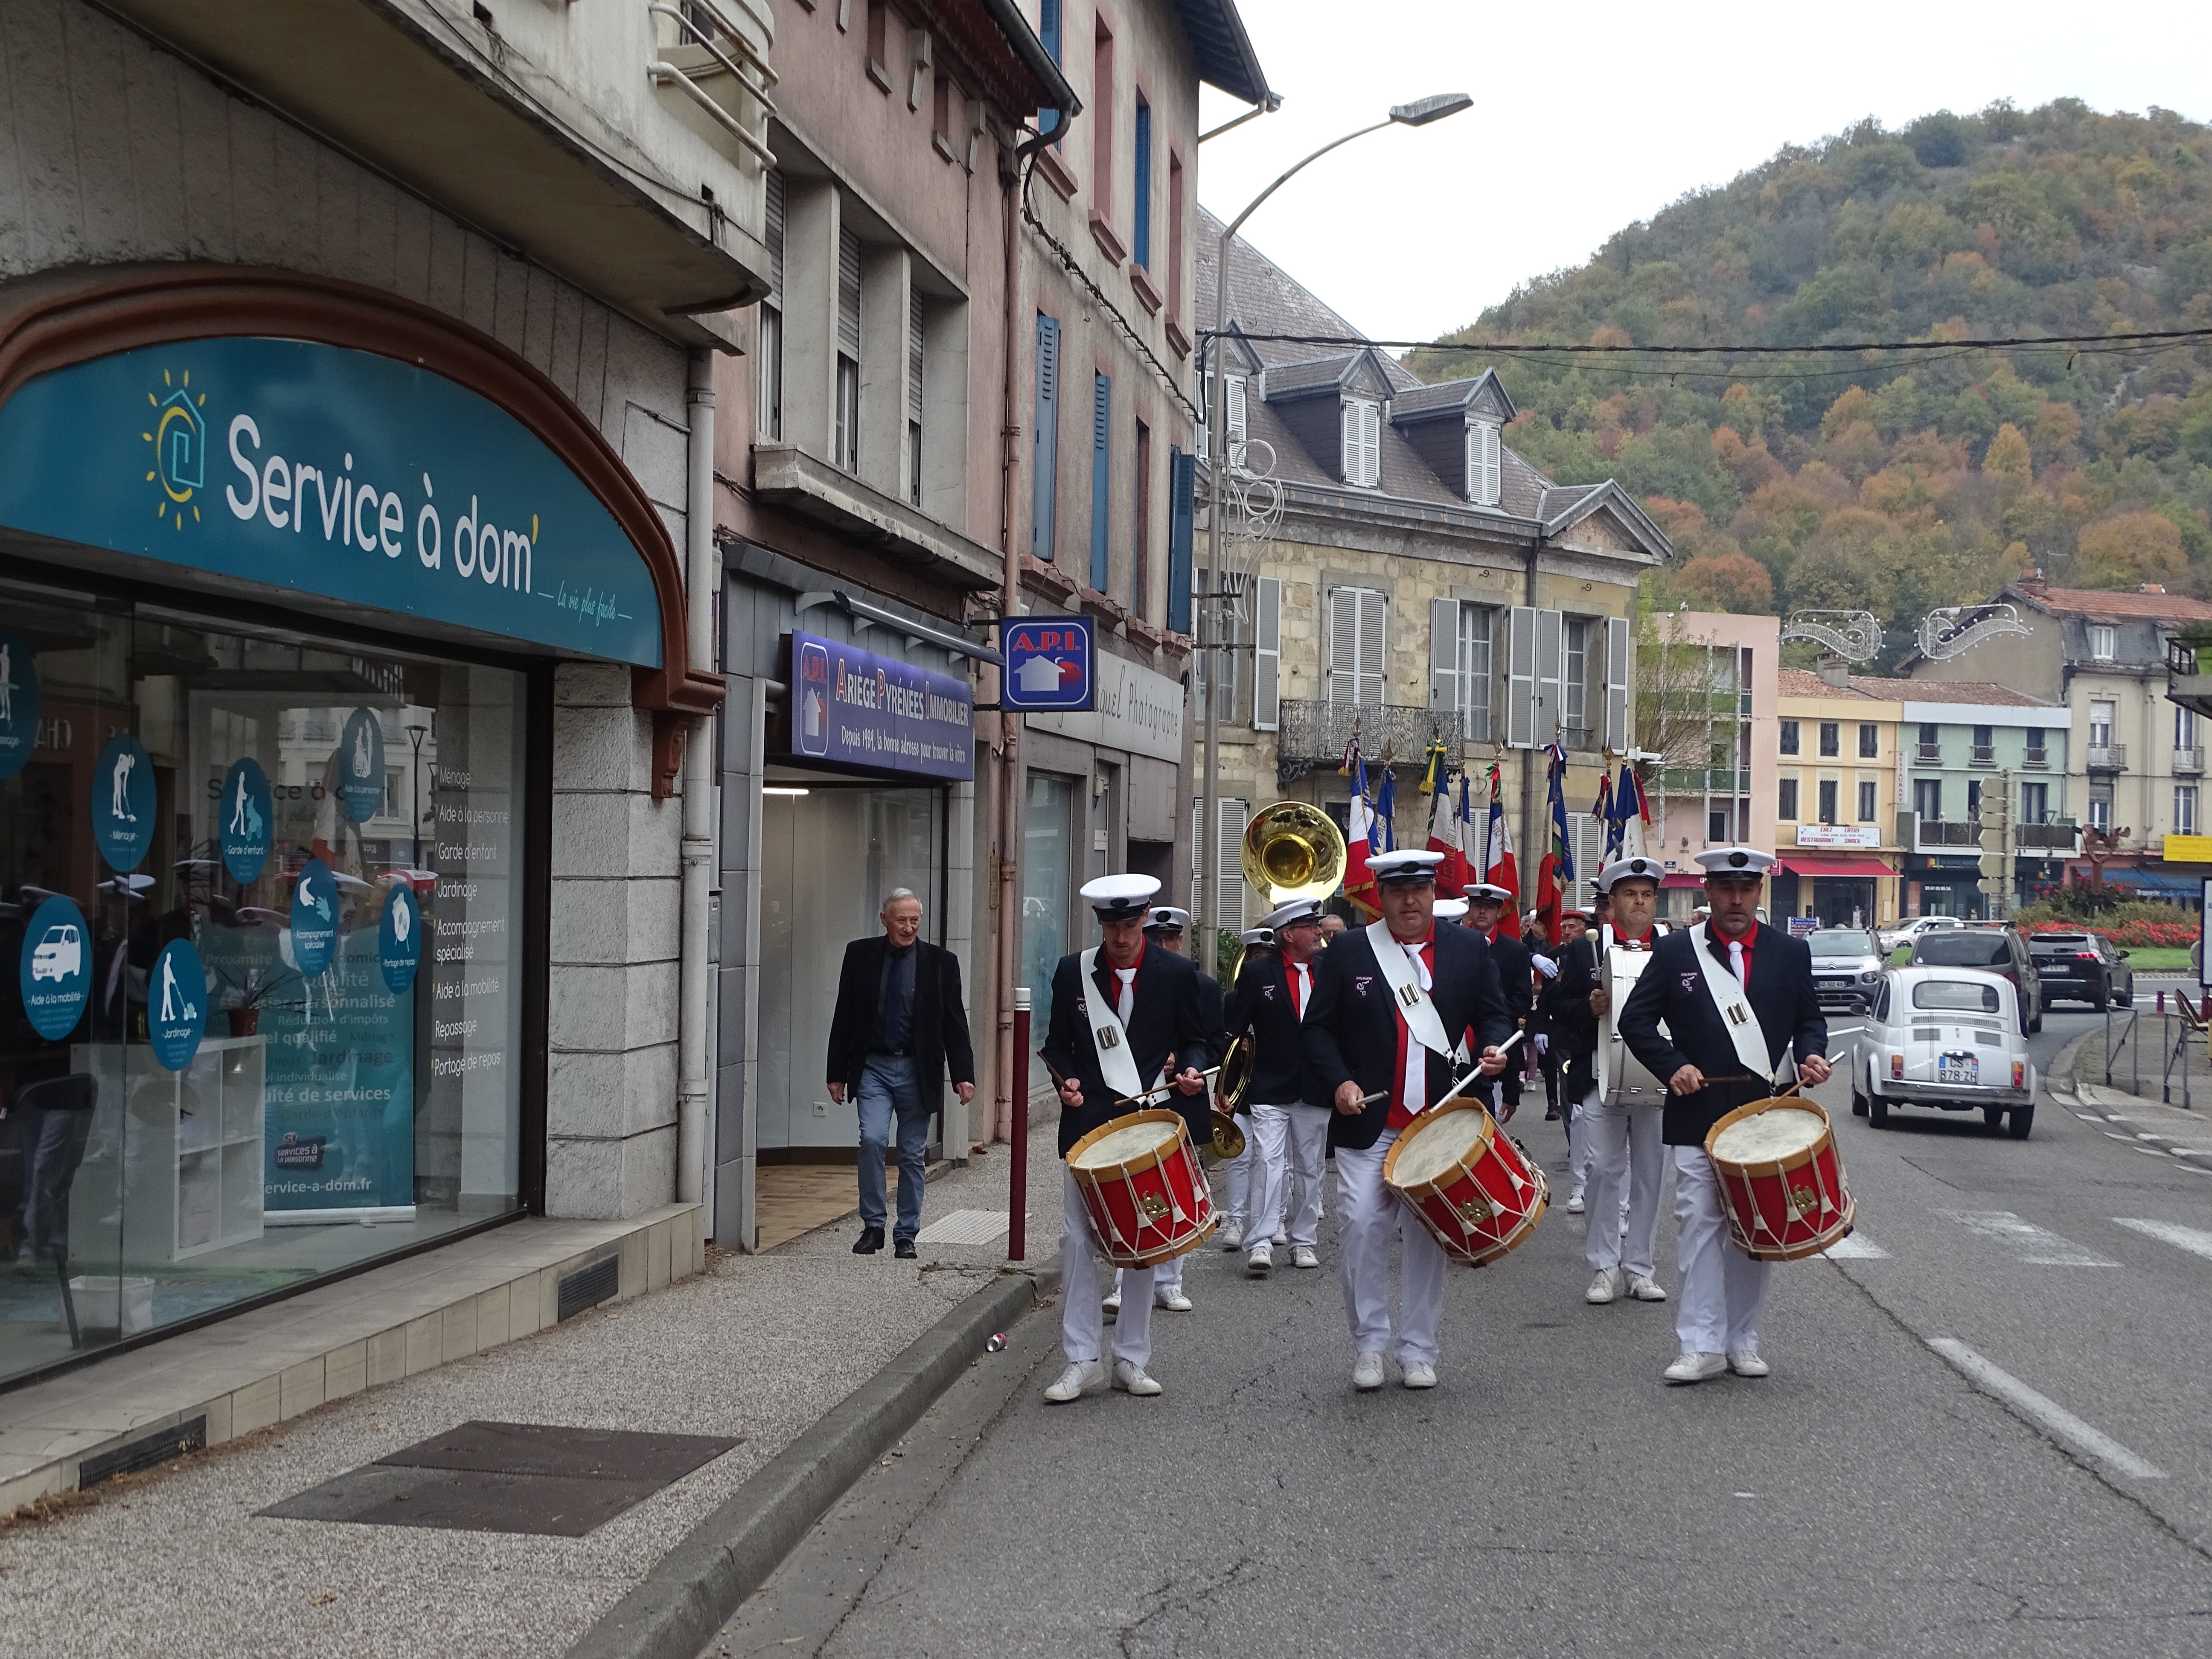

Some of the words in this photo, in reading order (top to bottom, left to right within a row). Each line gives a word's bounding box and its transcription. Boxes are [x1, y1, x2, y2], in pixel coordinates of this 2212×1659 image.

[226, 413, 404, 558] Service
[418, 472, 441, 570] à
[558, 580, 566, 608] La
[569, 589, 579, 610] vie
[579, 587, 596, 623] plus
[596, 591, 616, 627] facile
[1012, 632, 1081, 652] A.P.I.
[835, 658, 876, 708] ARIÈGE
[877, 668, 924, 720] PYRÉNÉES
[926, 681, 969, 727] IMMOBILIER
[1128, 679, 1178, 744] Photographe
[842, 725, 861, 753] Depuis
[877, 728, 882, 750] la
[884, 729, 899, 753] bonne
[901, 733, 919, 756] adresse
[921, 742, 931, 764] pour
[932, 740, 948, 761] trouver
[949, 741, 954, 761] la
[955, 743, 966, 763] vôtre
[439, 766, 470, 789] Ménage
[439, 804, 456, 822] Aide
[458, 806, 463, 822] à
[464, 806, 472, 823] la
[473, 809, 509, 827] personne
[227, 844, 243, 855] Garde
[439, 841, 463, 860] Garde
[465, 841, 497, 860] d'enfant
[438, 880, 478, 902] Jardinage
[296, 928, 333, 940] Accompagnement
[437, 917, 505, 938] Accompagnement
[305, 940, 325, 949] spécialisé
[437, 942, 474, 966] spécialisé
[384, 959, 399, 969] Portage
[404, 959, 415, 967] repas
[31, 994, 45, 1006] Aide
[45, 995, 50, 1004] à
[50, 993, 57, 1004] la
[57, 990, 81, 1003] mobilité
[436, 982, 453, 1000] Aide
[455, 981, 460, 997] à
[462, 980, 469, 997] la
[471, 977, 499, 995] mobilité
[164, 1027, 190, 1039] Jardinage
[435, 1019, 477, 1041] Repassage
[434, 1058, 465, 1077] Portage
[467, 1052, 477, 1070] de
[479, 1051, 501, 1071] repas
[1940, 1070, 1977, 1083] 878-ZH
[299, 1088, 320, 1103] de
[325, 1086, 391, 1102] services
[265, 1177, 372, 1194] ervice-a-dom.fr
